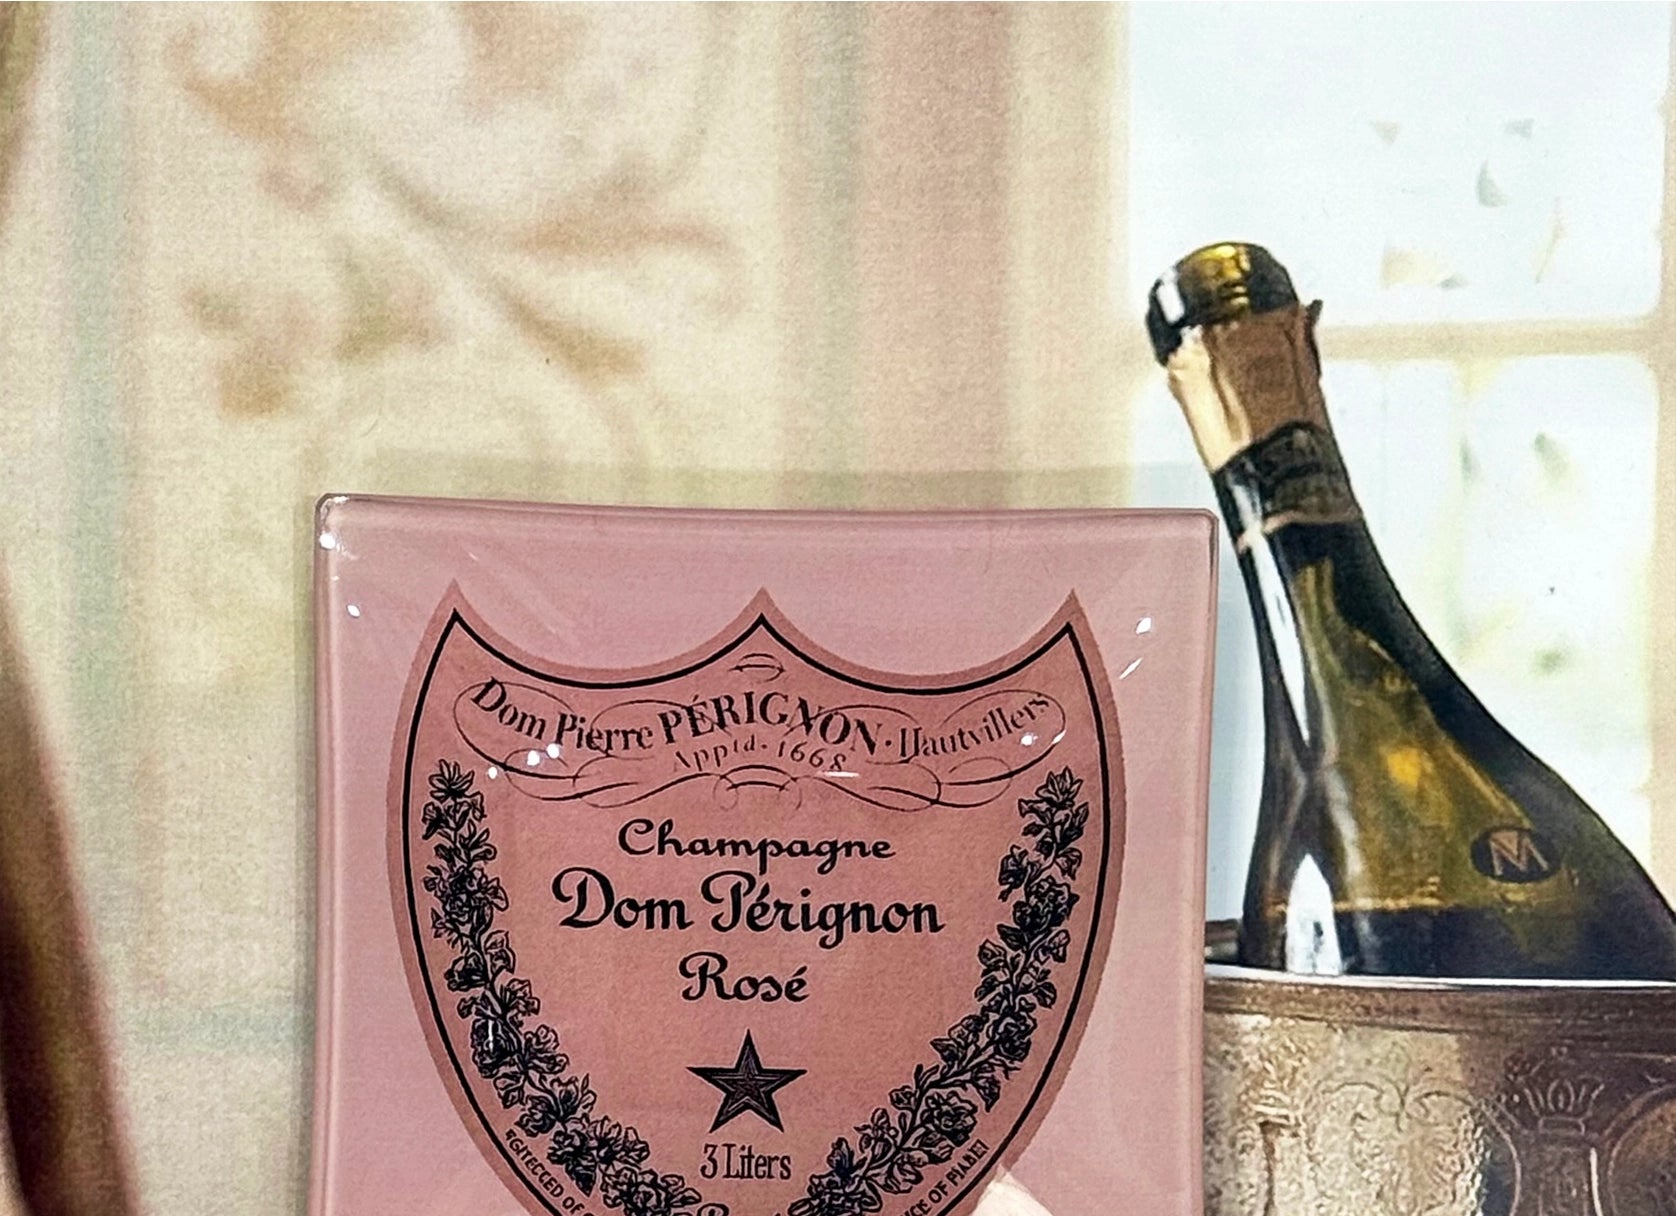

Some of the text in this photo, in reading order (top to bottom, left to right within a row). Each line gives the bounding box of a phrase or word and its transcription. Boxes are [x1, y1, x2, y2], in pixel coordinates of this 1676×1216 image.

[470, 676, 547, 740] Dom
[554, 710, 655, 752] Pierre
[777, 741, 848, 771] 1668
[618, 818, 896, 876] Champagne
[552, 866, 946, 950] Dom Pérignon
[678, 951, 811, 1002] Rosé
[700, 1143, 792, 1180] 3 Liters
[562, 1196, 585, 1215] OF
[928, 1181, 949, 1204] OF
